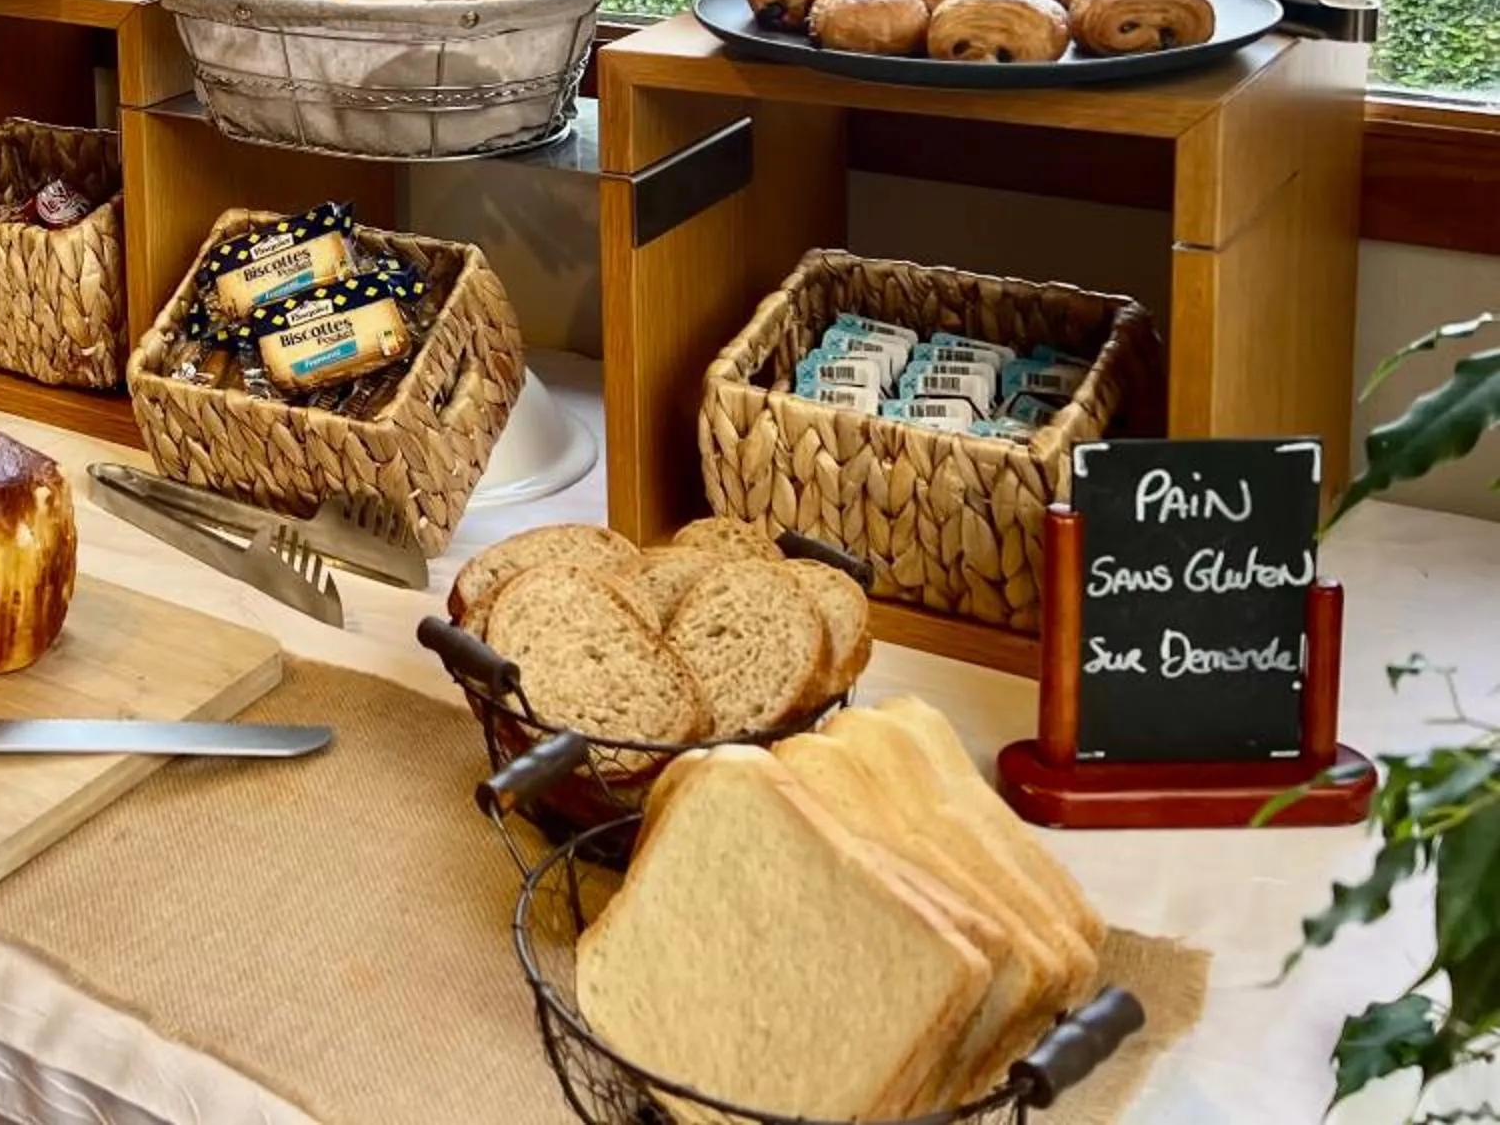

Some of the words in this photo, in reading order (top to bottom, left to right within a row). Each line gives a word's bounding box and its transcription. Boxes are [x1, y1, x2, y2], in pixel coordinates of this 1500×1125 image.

[243, 248, 311, 281] Biscottes
[279, 318, 354, 348] Biscottes
[1087, 556, 1173, 597] SANS
